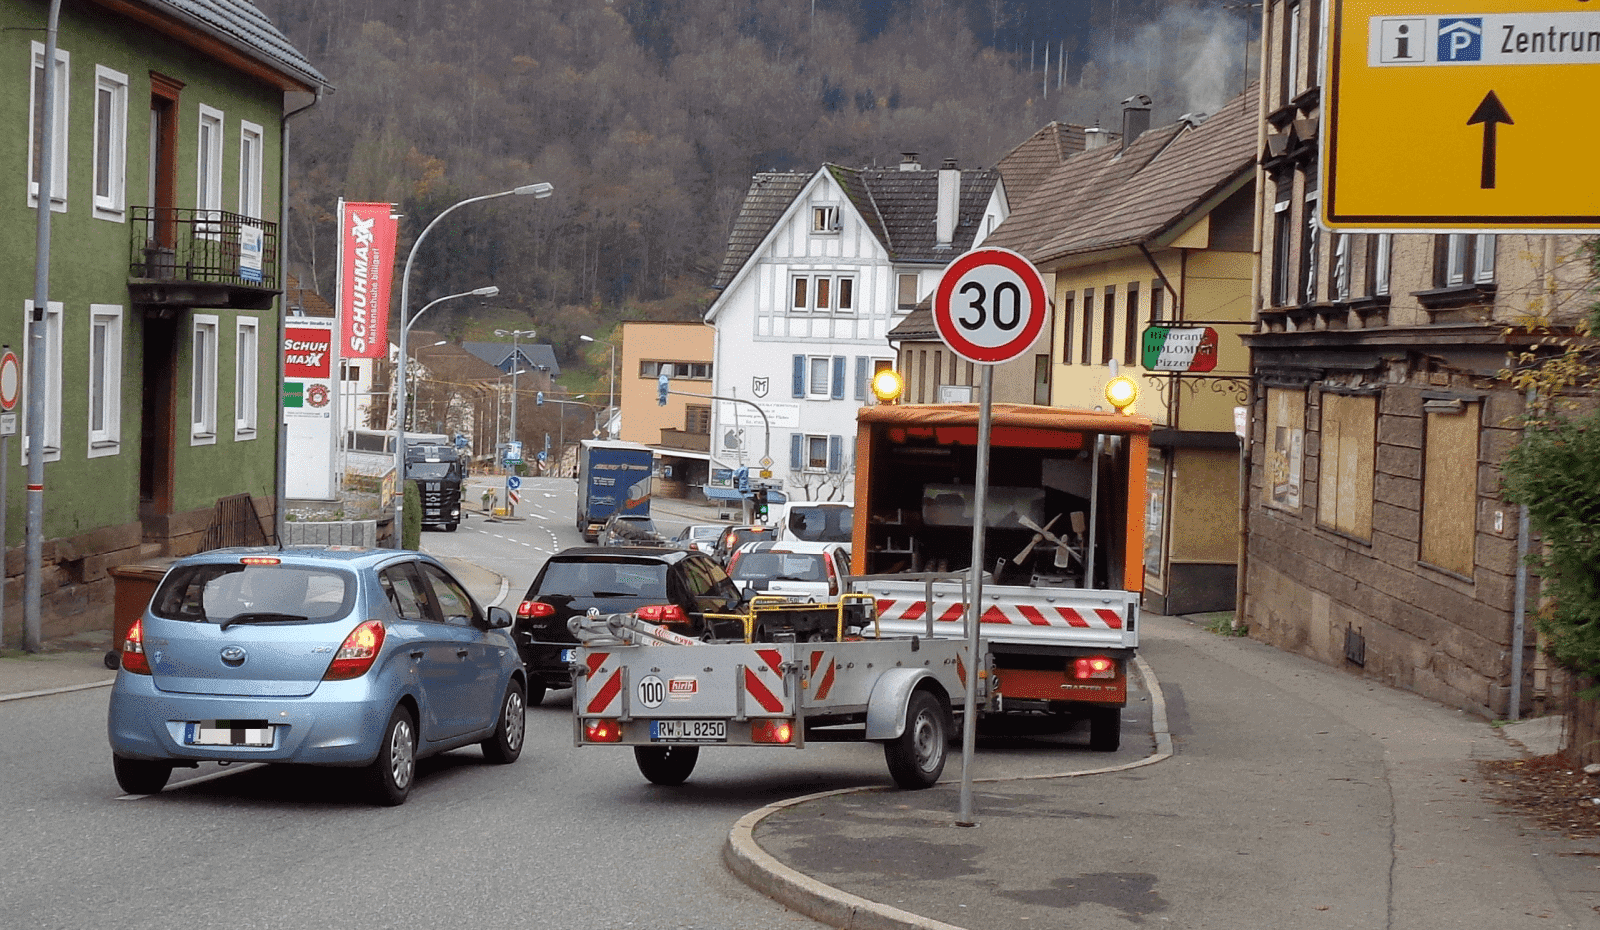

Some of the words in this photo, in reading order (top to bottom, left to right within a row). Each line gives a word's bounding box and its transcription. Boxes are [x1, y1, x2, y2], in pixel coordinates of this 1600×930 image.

[959, 281, 1020, 331] 30
[284, 339, 328, 352] SCHUH
[641, 682, 663, 703] 100
[660, 722, 675, 736] RW
[683, 722, 691, 736] L
[694, 722, 724, 737] 8250
